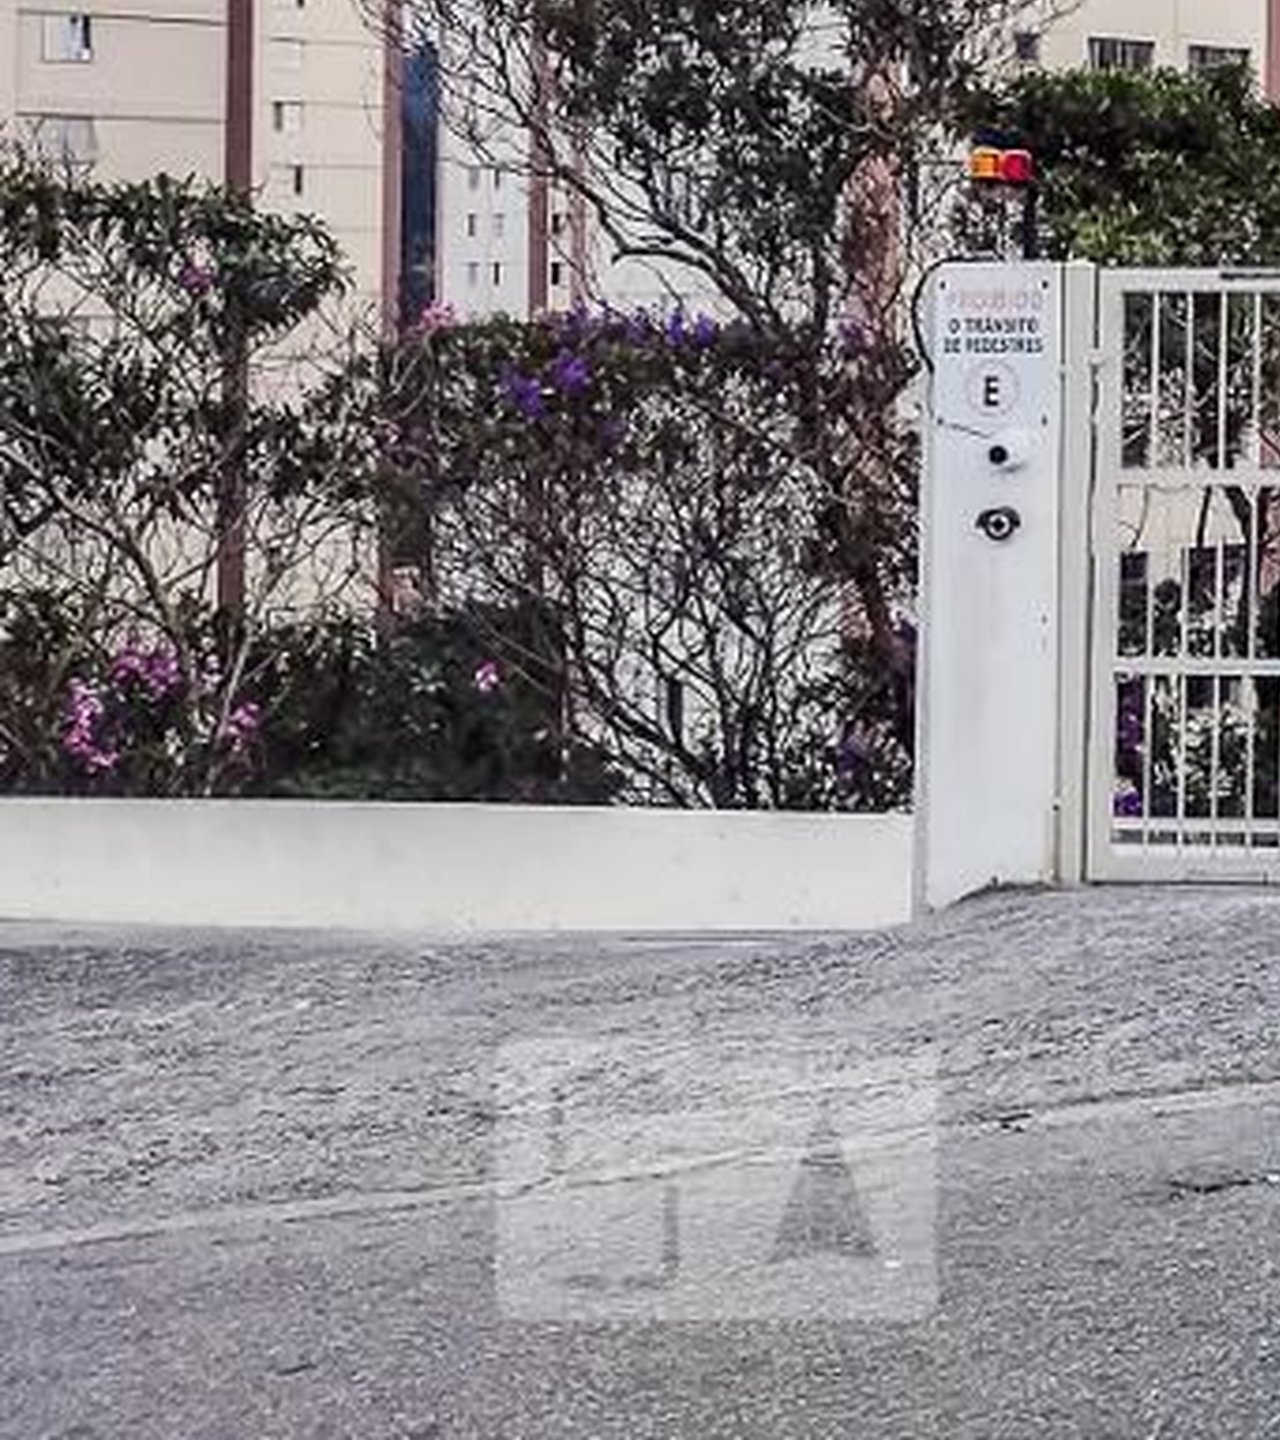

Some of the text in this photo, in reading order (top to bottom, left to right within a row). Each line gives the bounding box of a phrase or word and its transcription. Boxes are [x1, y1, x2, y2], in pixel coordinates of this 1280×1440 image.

[948, 317, 961, 334] O
[943, 337, 1044, 354] DE PEDESTRES
[983, 376, 999, 407] E
